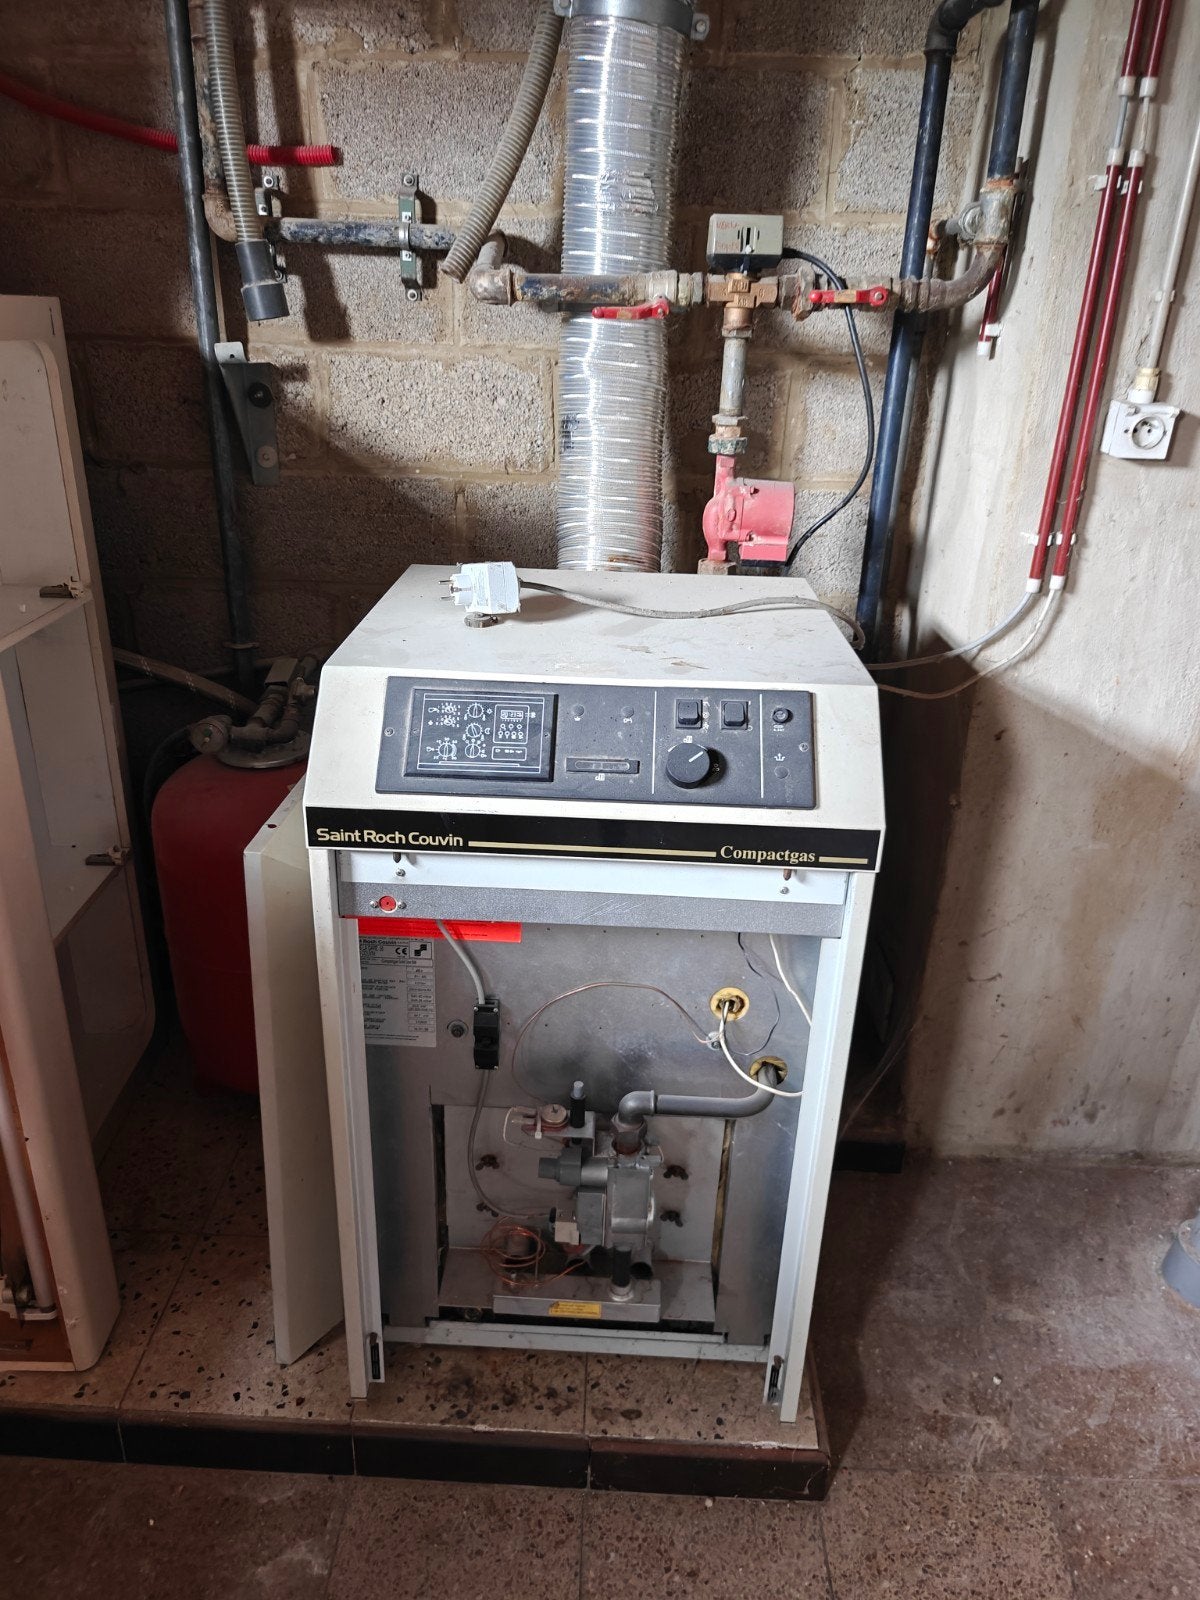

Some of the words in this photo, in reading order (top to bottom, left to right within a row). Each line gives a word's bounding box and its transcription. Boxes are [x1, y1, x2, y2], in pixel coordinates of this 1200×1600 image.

[316, 827, 362, 843] Saint
[364, 829, 406, 845] Roch
[408, 831, 464, 847] Couvin
[720, 845, 816, 865] Compactgas
